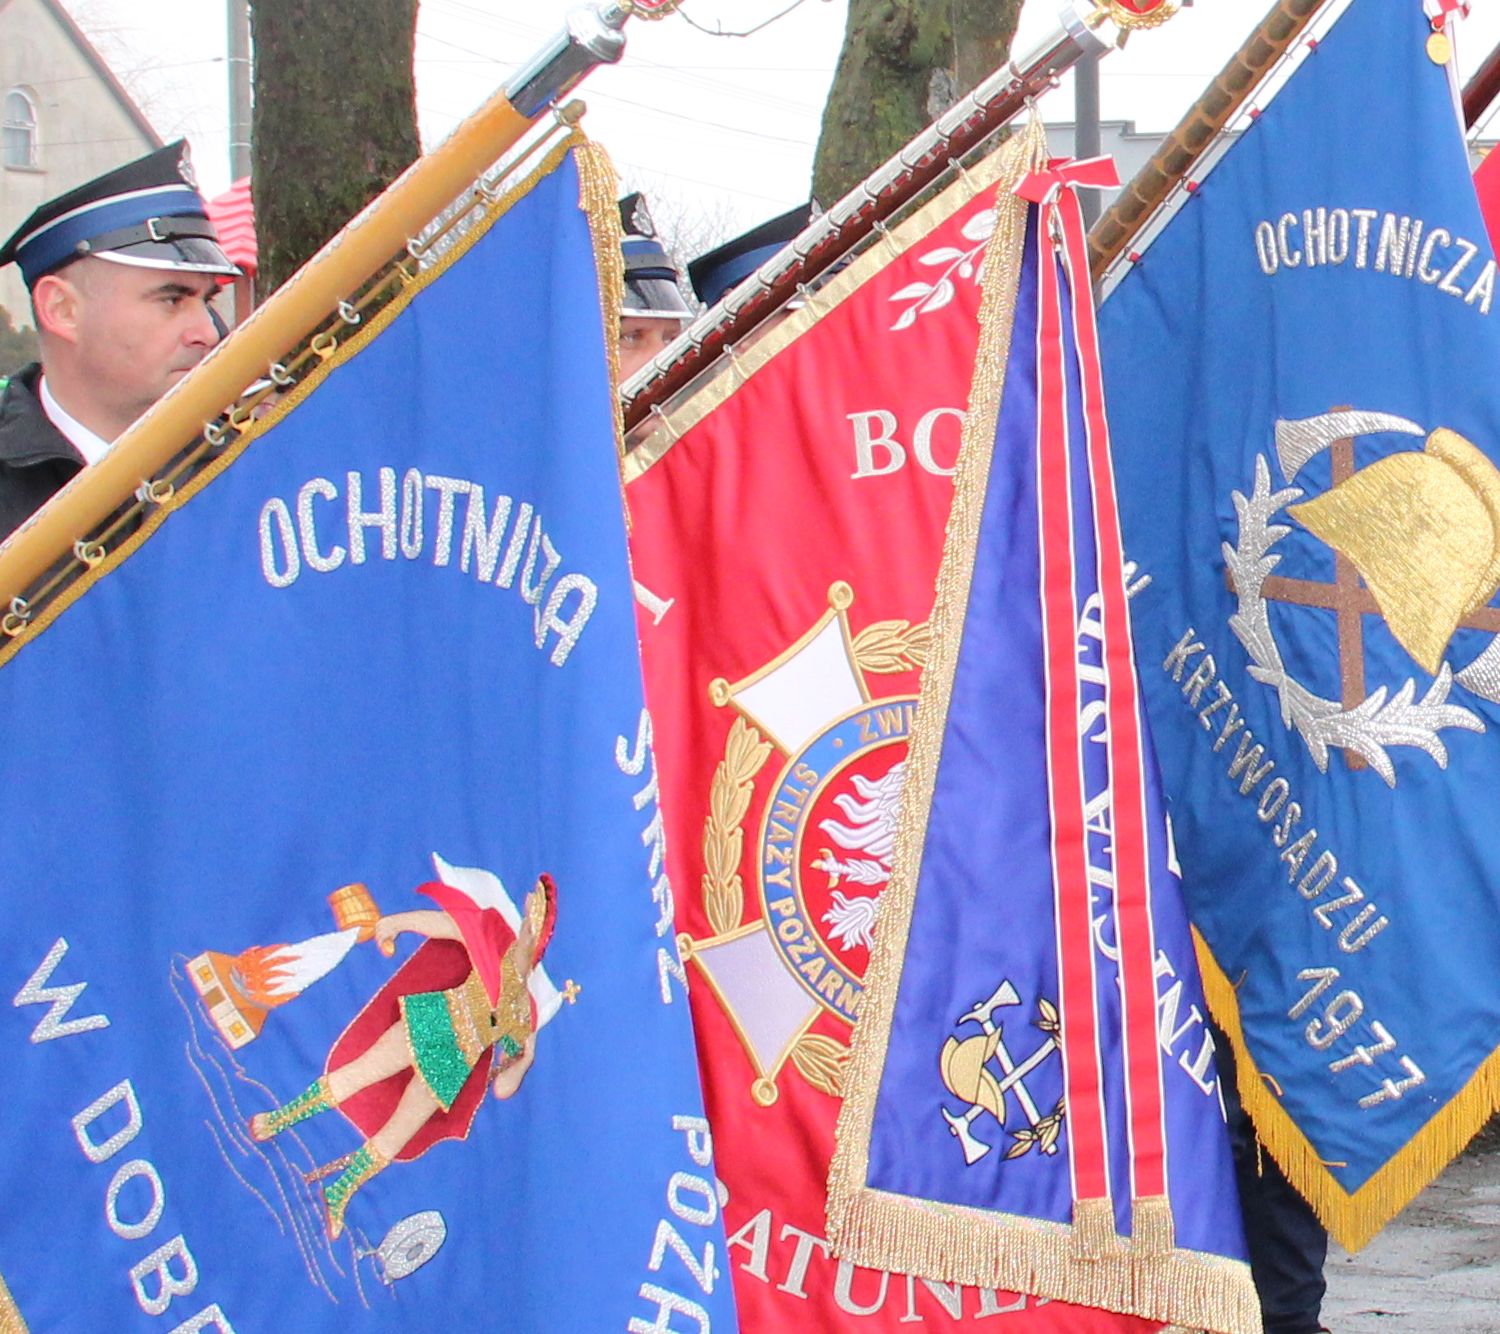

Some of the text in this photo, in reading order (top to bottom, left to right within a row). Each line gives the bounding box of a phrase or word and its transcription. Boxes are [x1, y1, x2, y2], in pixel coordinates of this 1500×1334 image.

[1255, 206, 1497, 315] OCHOTNICZA
[765, 762, 819, 890] STRAŻY
[1162, 627, 1389, 955] KRZYWOSADZU
[11, 937, 110, 1044] W
[1287, 966, 1426, 1109] 1977
